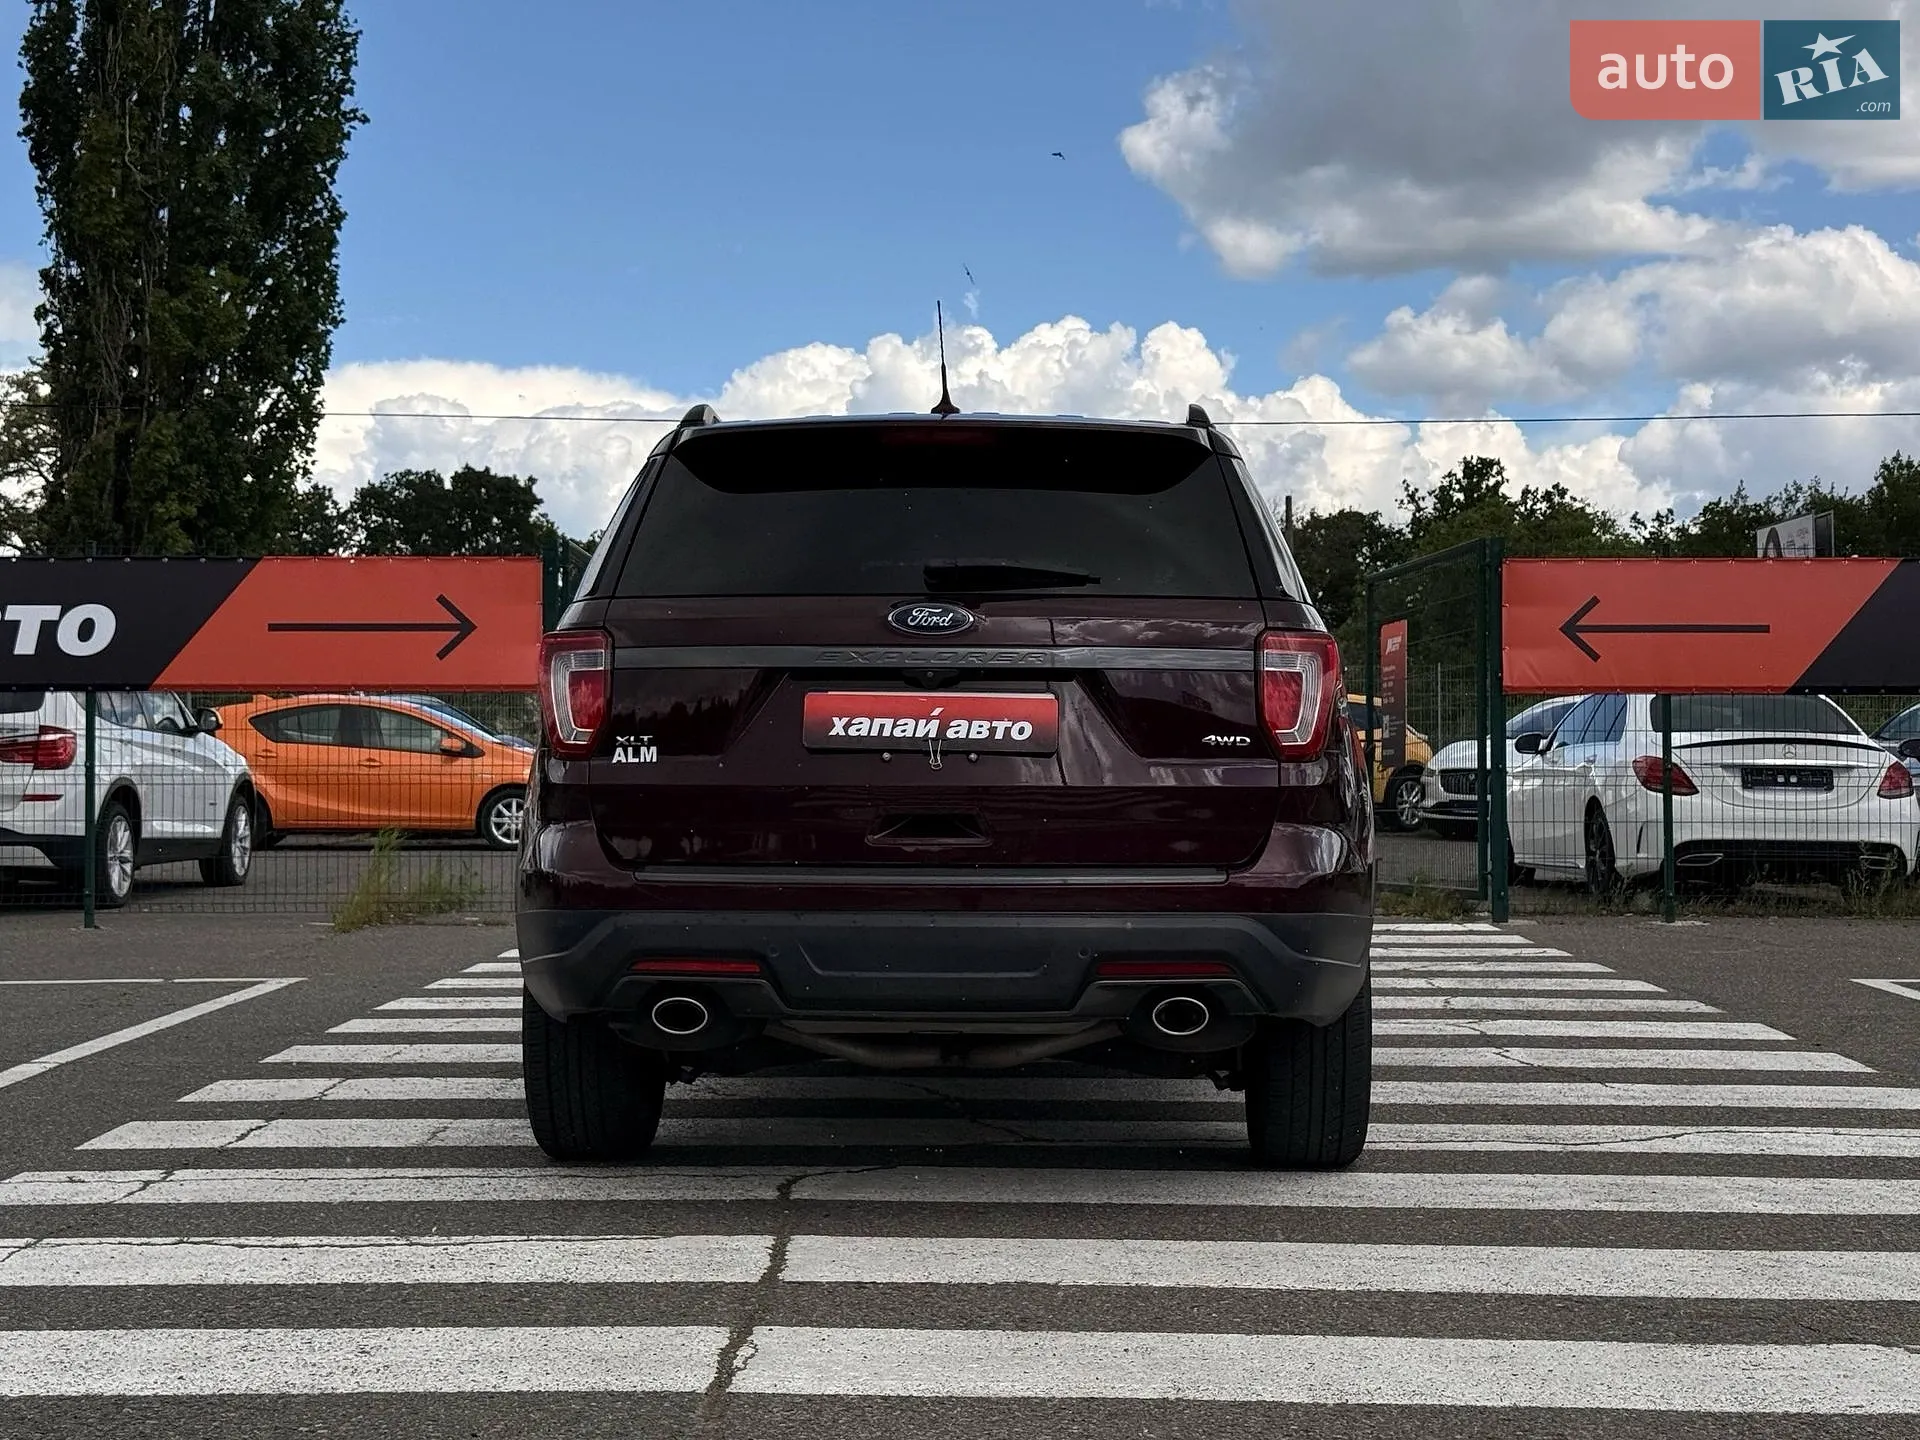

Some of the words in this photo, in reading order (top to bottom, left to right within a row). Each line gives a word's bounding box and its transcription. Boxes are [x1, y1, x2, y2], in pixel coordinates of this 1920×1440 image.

[907, 607, 954, 627] Ford
[817, 651, 1049, 664] EXPLORER
[946, 718, 1034, 741] авто
[615, 735, 654, 746] XLT
[1201, 734, 1252, 746] 4WD
[611, 746, 658, 764] ALM
